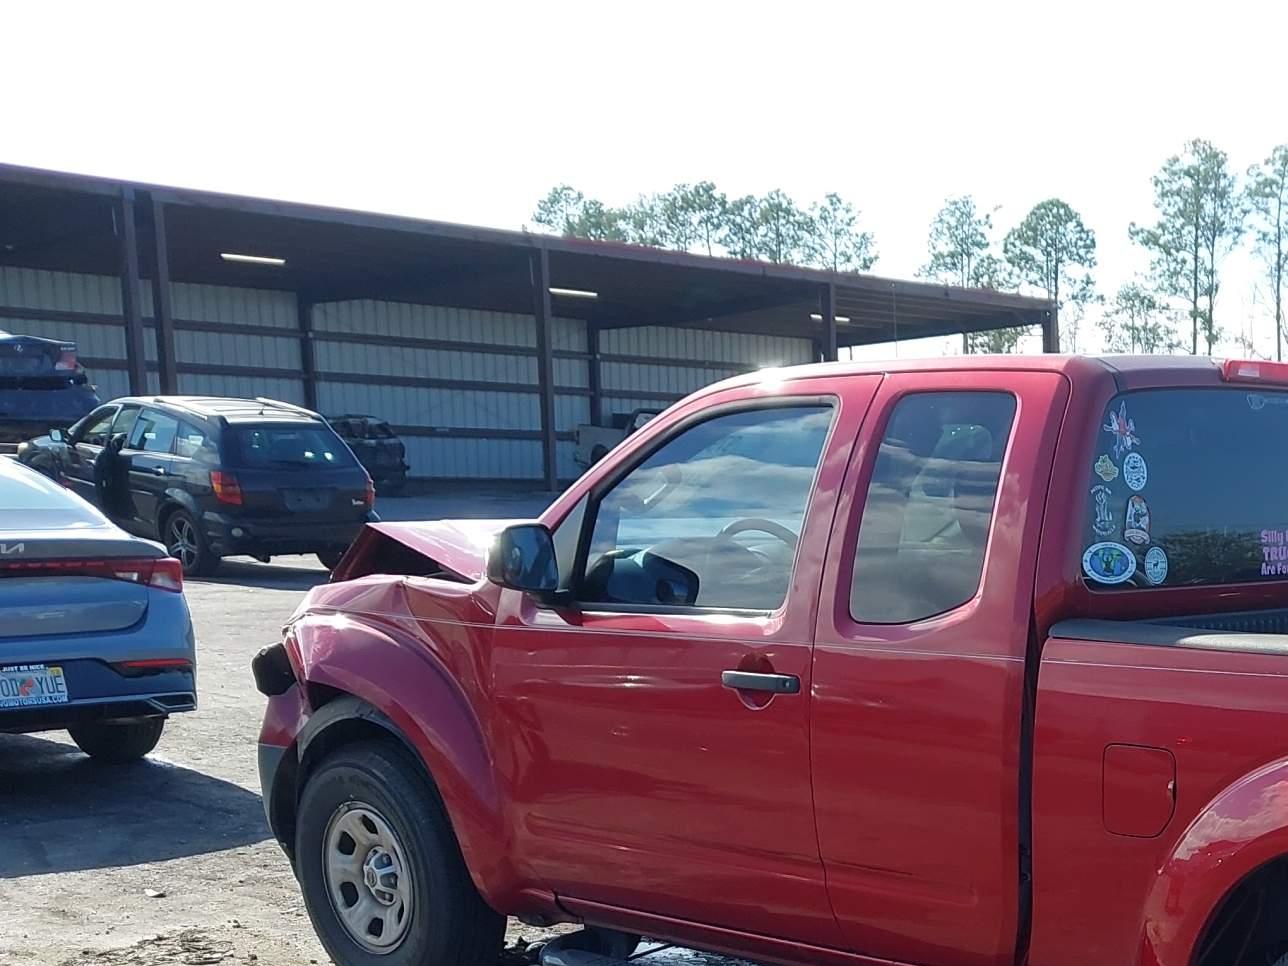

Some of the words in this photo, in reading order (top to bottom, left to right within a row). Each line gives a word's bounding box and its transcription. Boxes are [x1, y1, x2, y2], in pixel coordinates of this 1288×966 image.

[1261, 529, 1283, 546] Silly
[1261, 562, 1276, 575] Are
[35, 675, 65, 694] YUE
